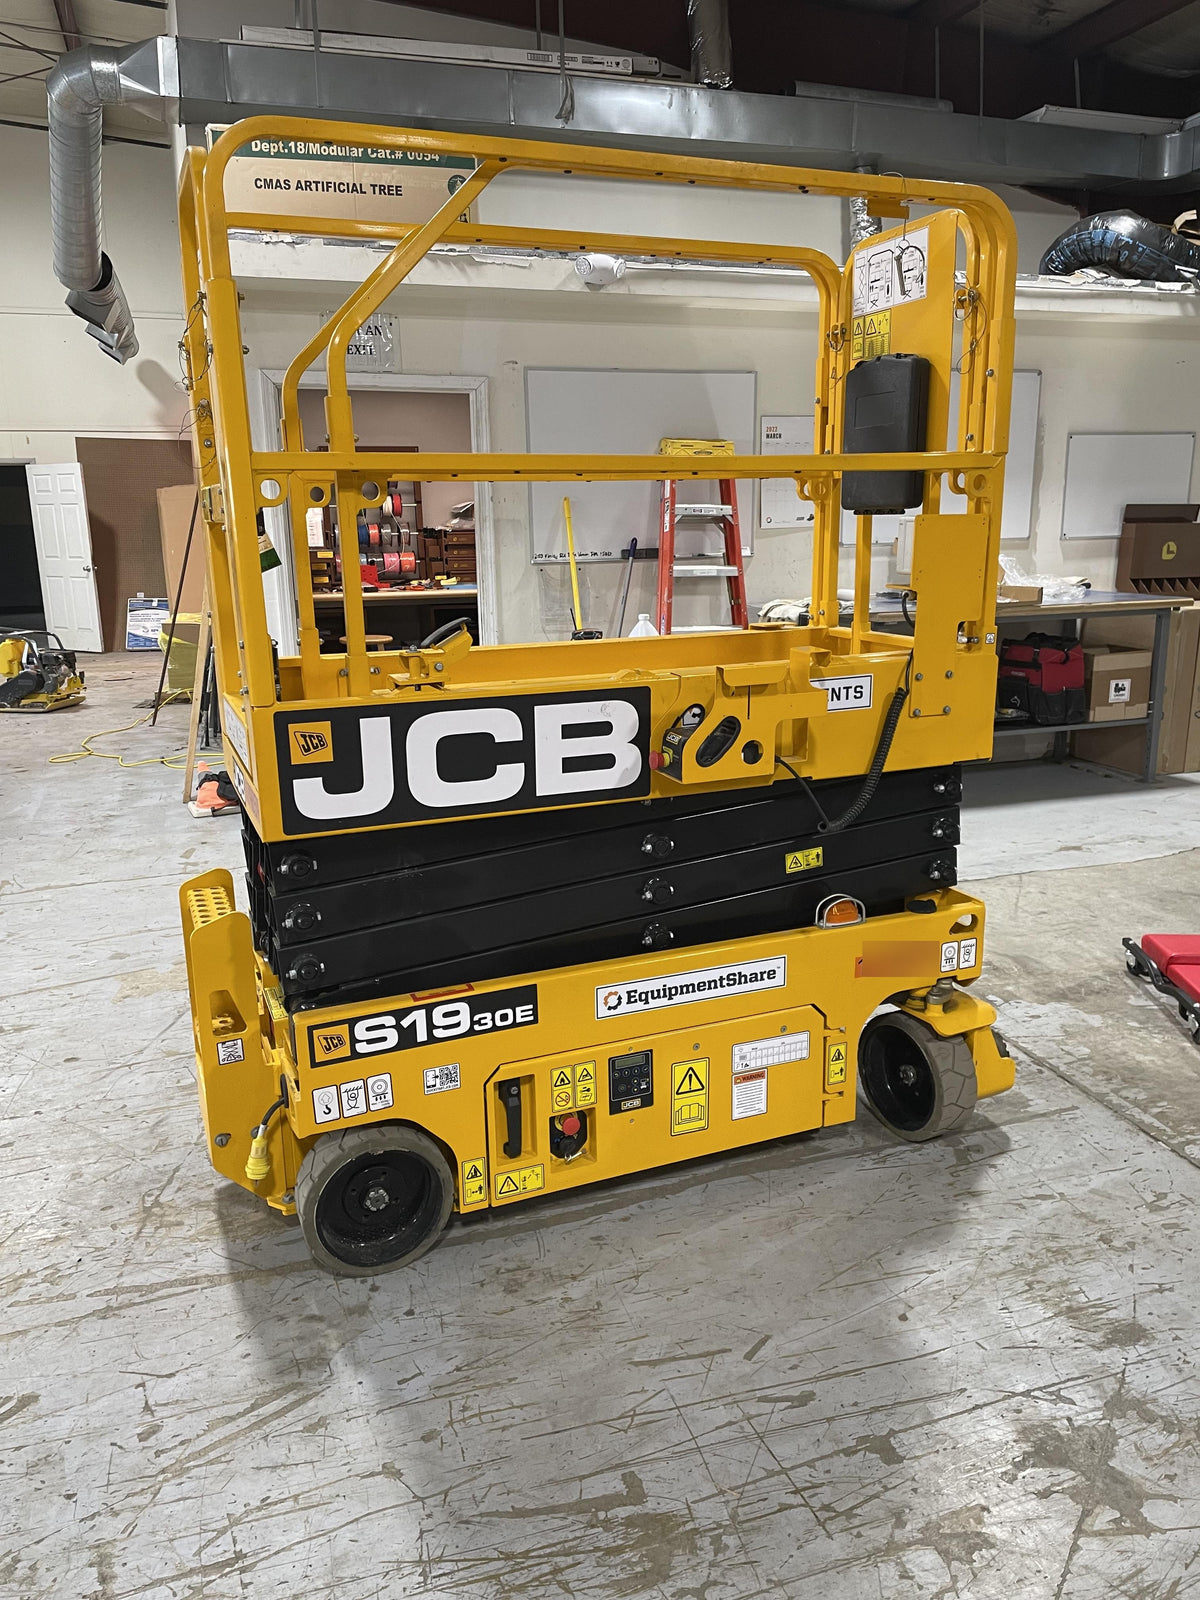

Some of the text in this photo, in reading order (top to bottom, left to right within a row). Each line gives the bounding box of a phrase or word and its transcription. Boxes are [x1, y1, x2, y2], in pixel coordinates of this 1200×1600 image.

[251, 140, 363, 157] Dept.18/Modular
[254, 177, 403, 197] CMAS ARTIFICIAL TREE
[366, 325, 382, 336] AN
[347, 344, 374, 355] EXIT
[825, 685, 864, 701] NTS
[300, 733, 326, 753] JCB
[293, 700, 642, 819] JCB
[626, 968, 777, 1006] EquipmentShare
[323, 1036, 344, 1052] JCB
[742, 1072, 765, 1081] WARNING
